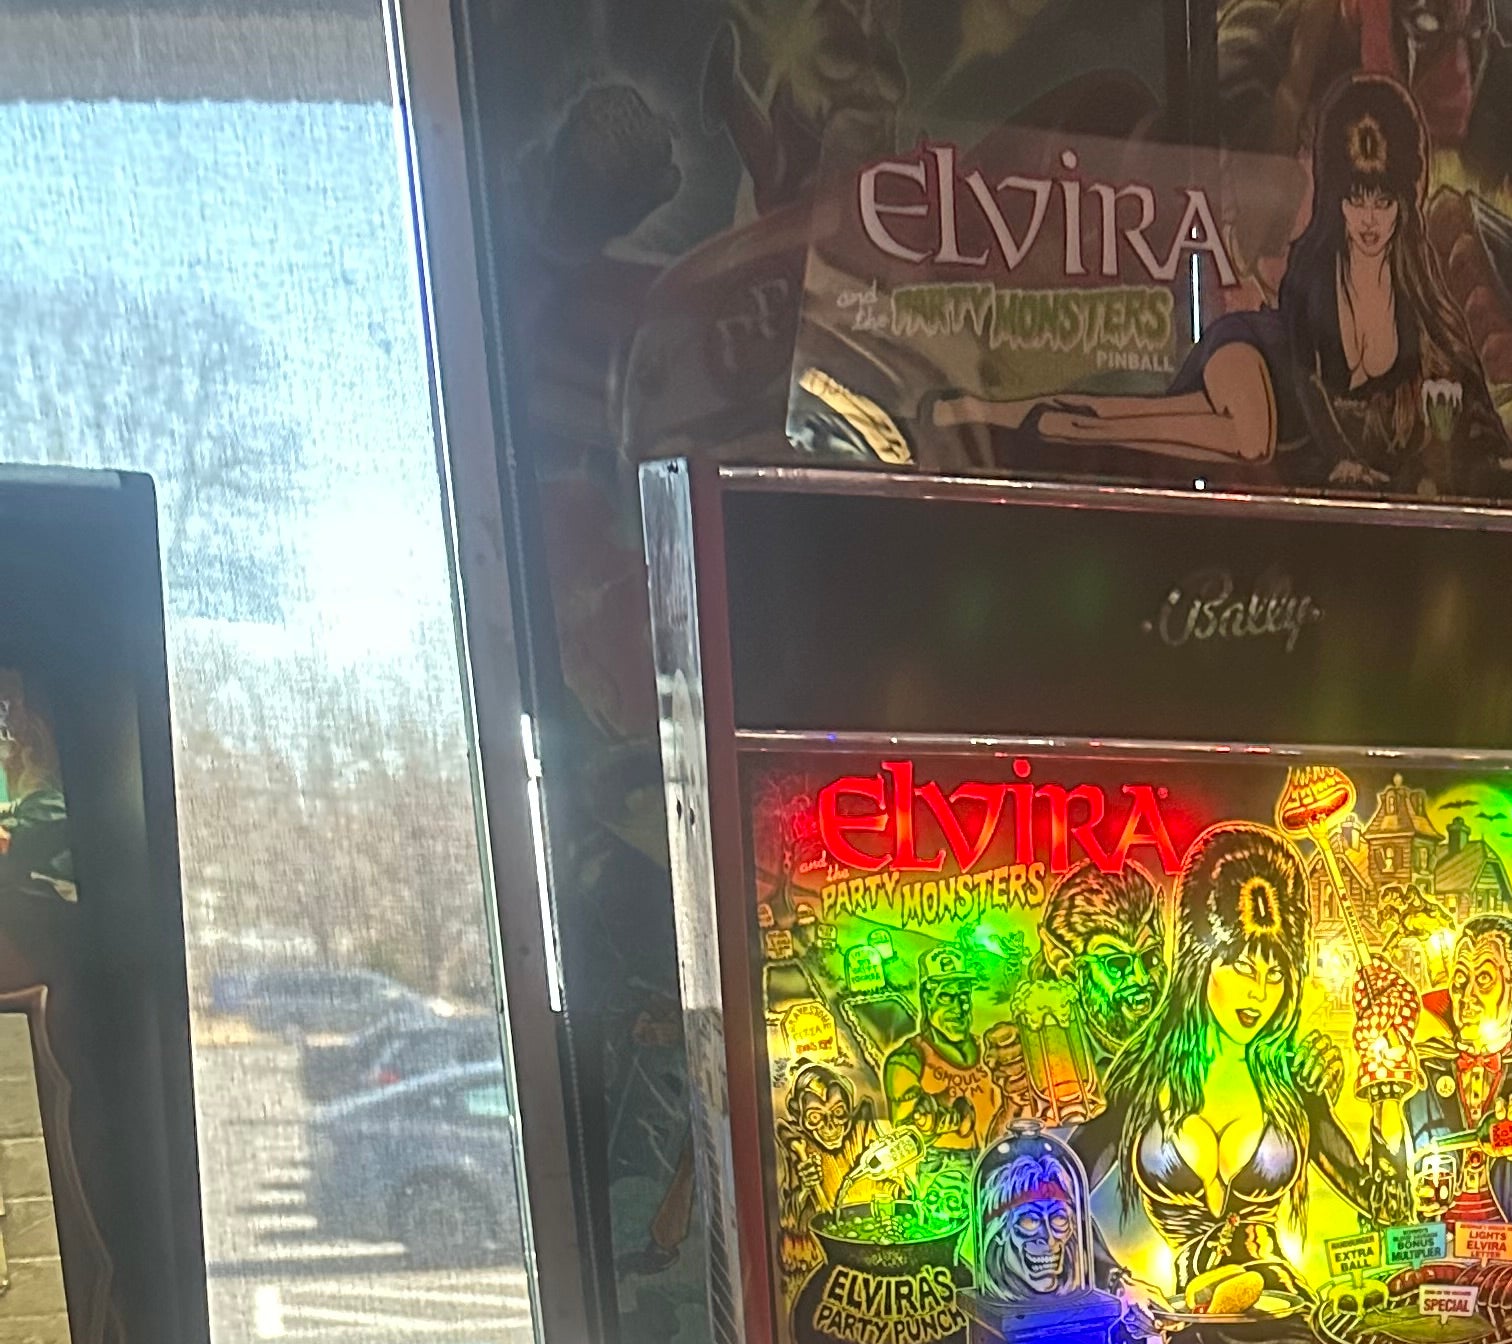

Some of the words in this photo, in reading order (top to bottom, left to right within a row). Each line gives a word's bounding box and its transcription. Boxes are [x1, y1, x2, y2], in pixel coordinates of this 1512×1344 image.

[859, 145, 1239, 287] ELVIRA
[990, 285, 1174, 351] MONSTERS
[1096, 350, 1174, 374] PINBALL
[1158, 570, 1313, 652] Bally
[817, 760, 1186, 877] ELVIRA
[821, 871, 900, 921] PARTY
[901, 862, 1047, 929] MONSTERS
[1397, 1238, 1435, 1250] BONUS
[1466, 1239, 1507, 1252] ELVIRA
[1469, 1229, 1507, 1241] LIGHTS
[1334, 1246, 1375, 1263] EXTRA
[1340, 1258, 1372, 1273] BALL
[826, 1265, 955, 1317] ELVIRA'S
[1423, 1297, 1471, 1314] SPECIAL
